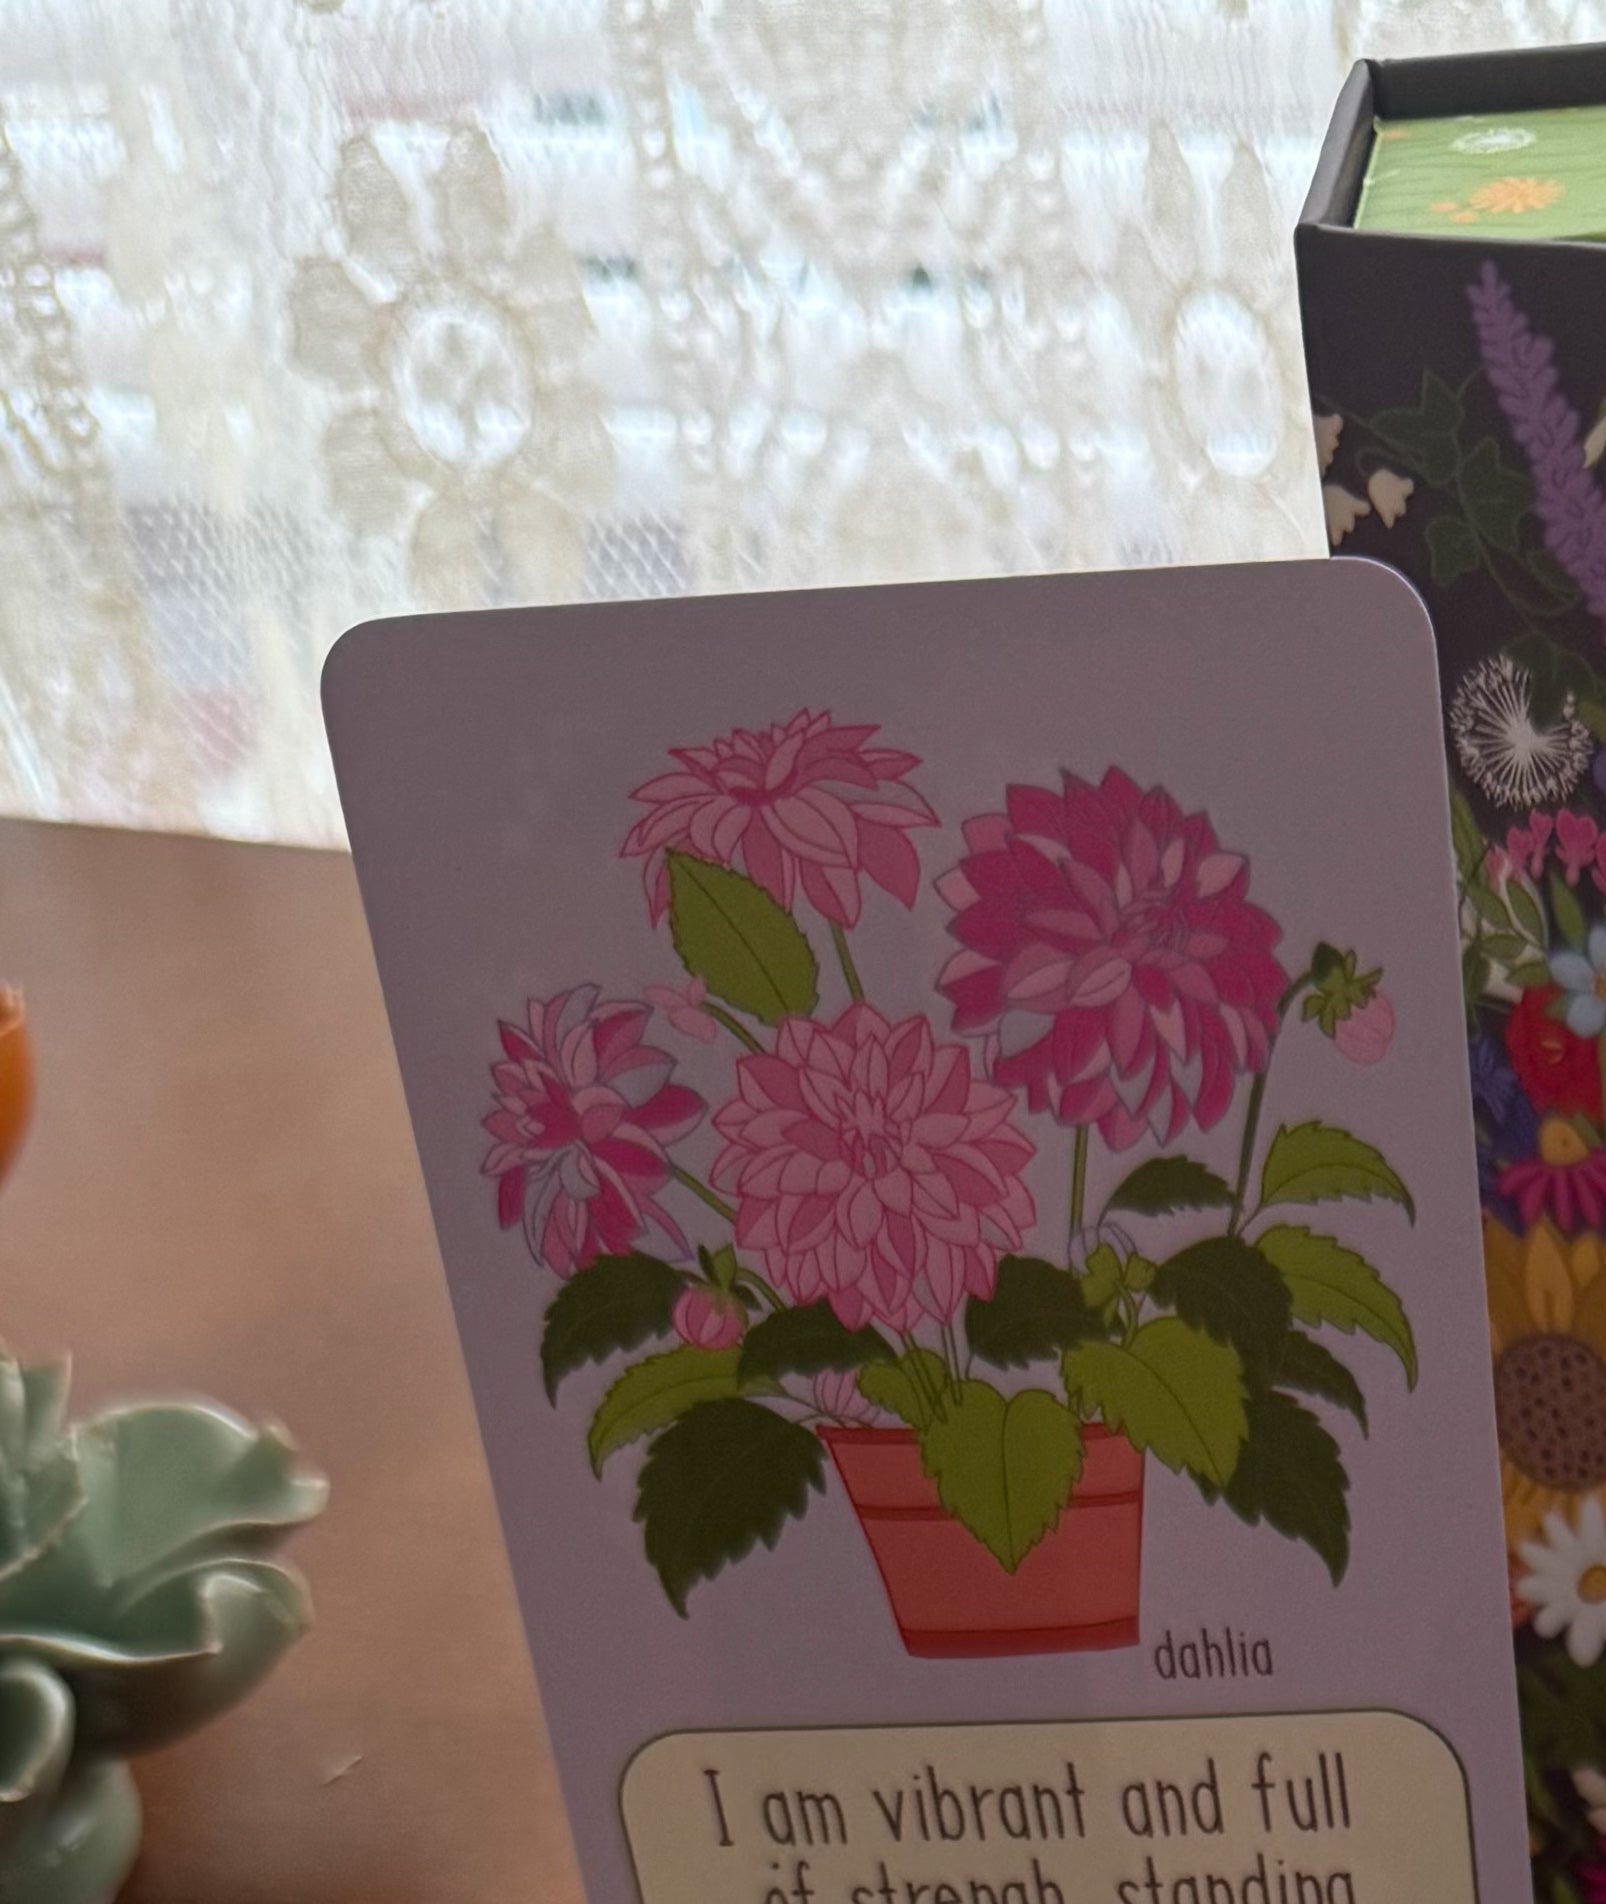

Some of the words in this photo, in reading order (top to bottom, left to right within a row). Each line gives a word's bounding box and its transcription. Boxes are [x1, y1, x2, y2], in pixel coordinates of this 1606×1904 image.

[1154, 1628, 1274, 1681] dahlia
[704, 1769, 735, 1847] I
[763, 1787, 848, 1847] am
[874, 1761, 1087, 1843] vibrant
[1120, 1758, 1225, 1834] and
[1251, 1751, 1352, 1833] full
